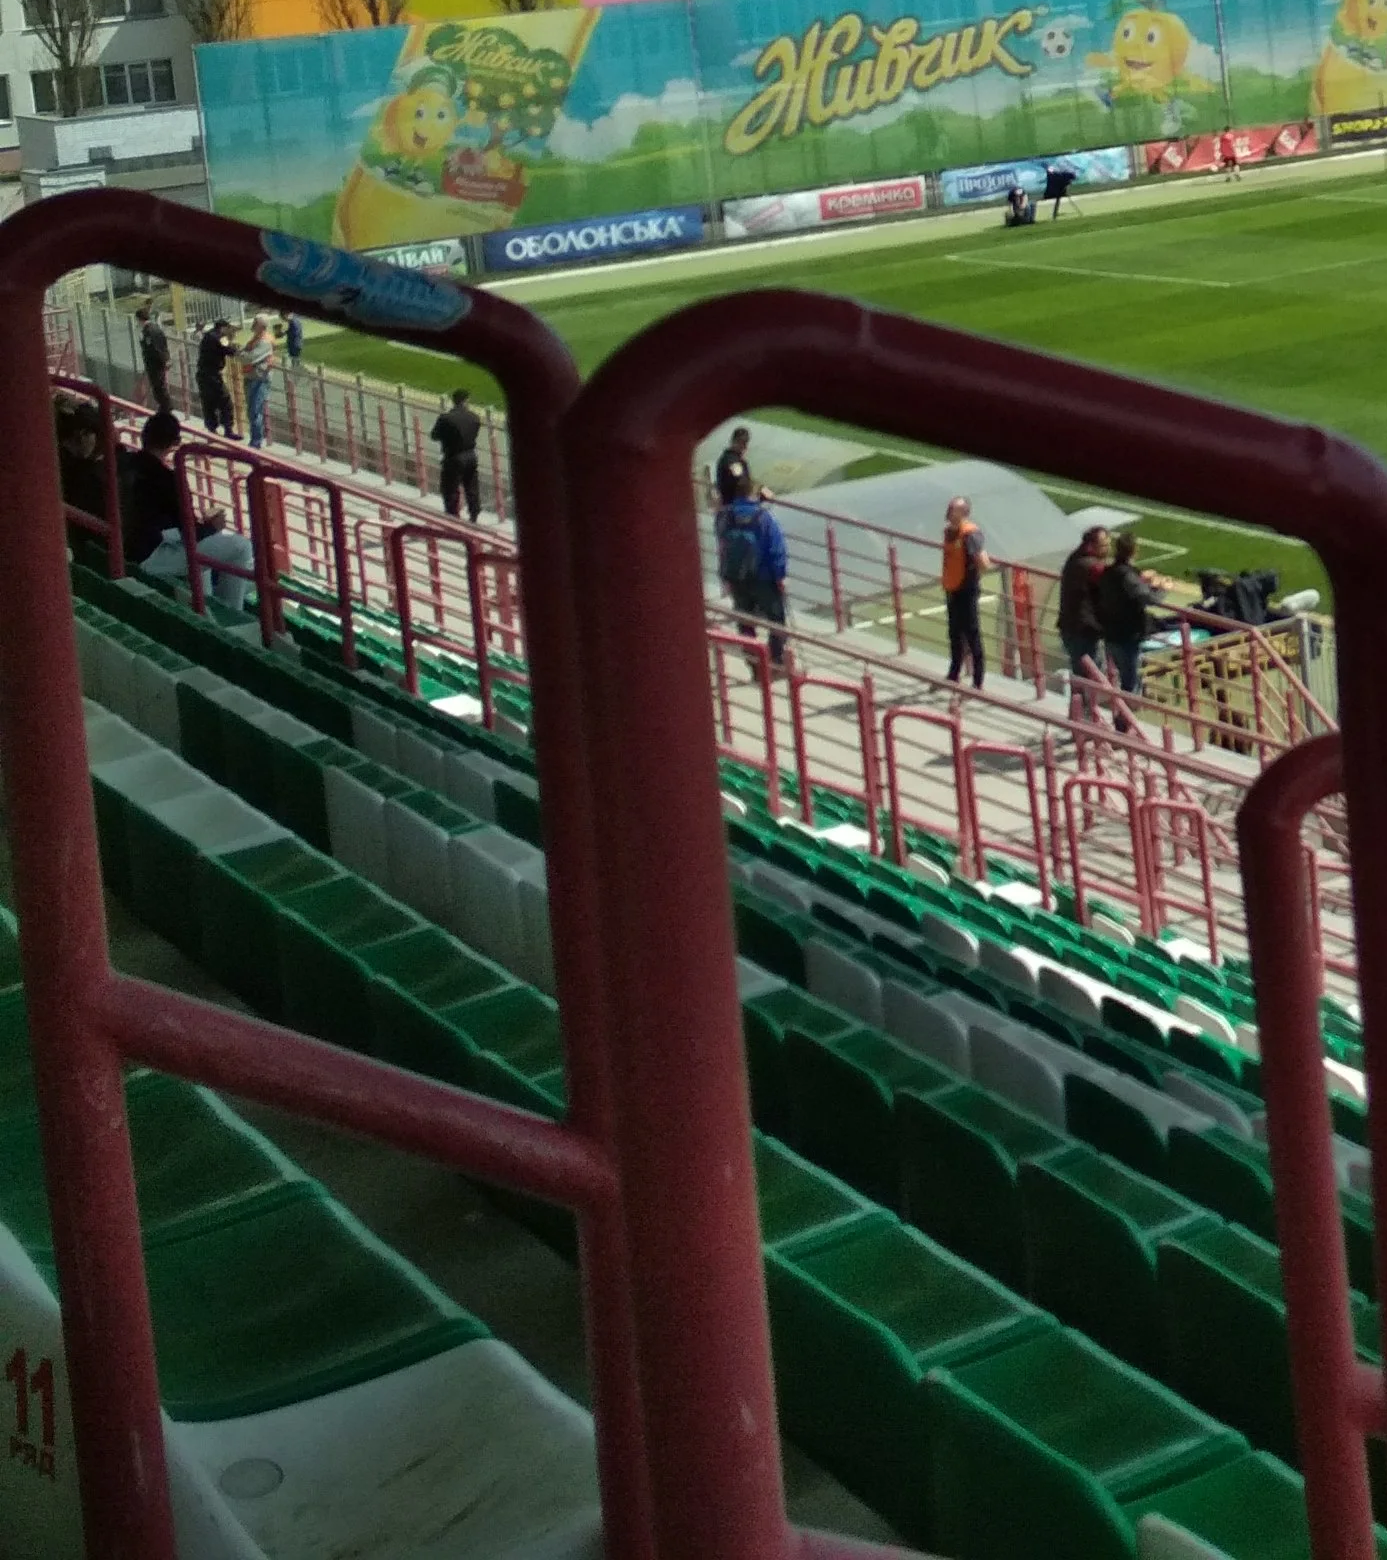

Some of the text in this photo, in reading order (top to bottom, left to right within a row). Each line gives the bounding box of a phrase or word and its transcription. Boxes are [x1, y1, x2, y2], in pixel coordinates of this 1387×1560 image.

[723, 9, 1034, 156] Живчик
[504, 215, 683, 262] ОБОЛОНСЬКА
[4, 1347, 55, 1446] 11
